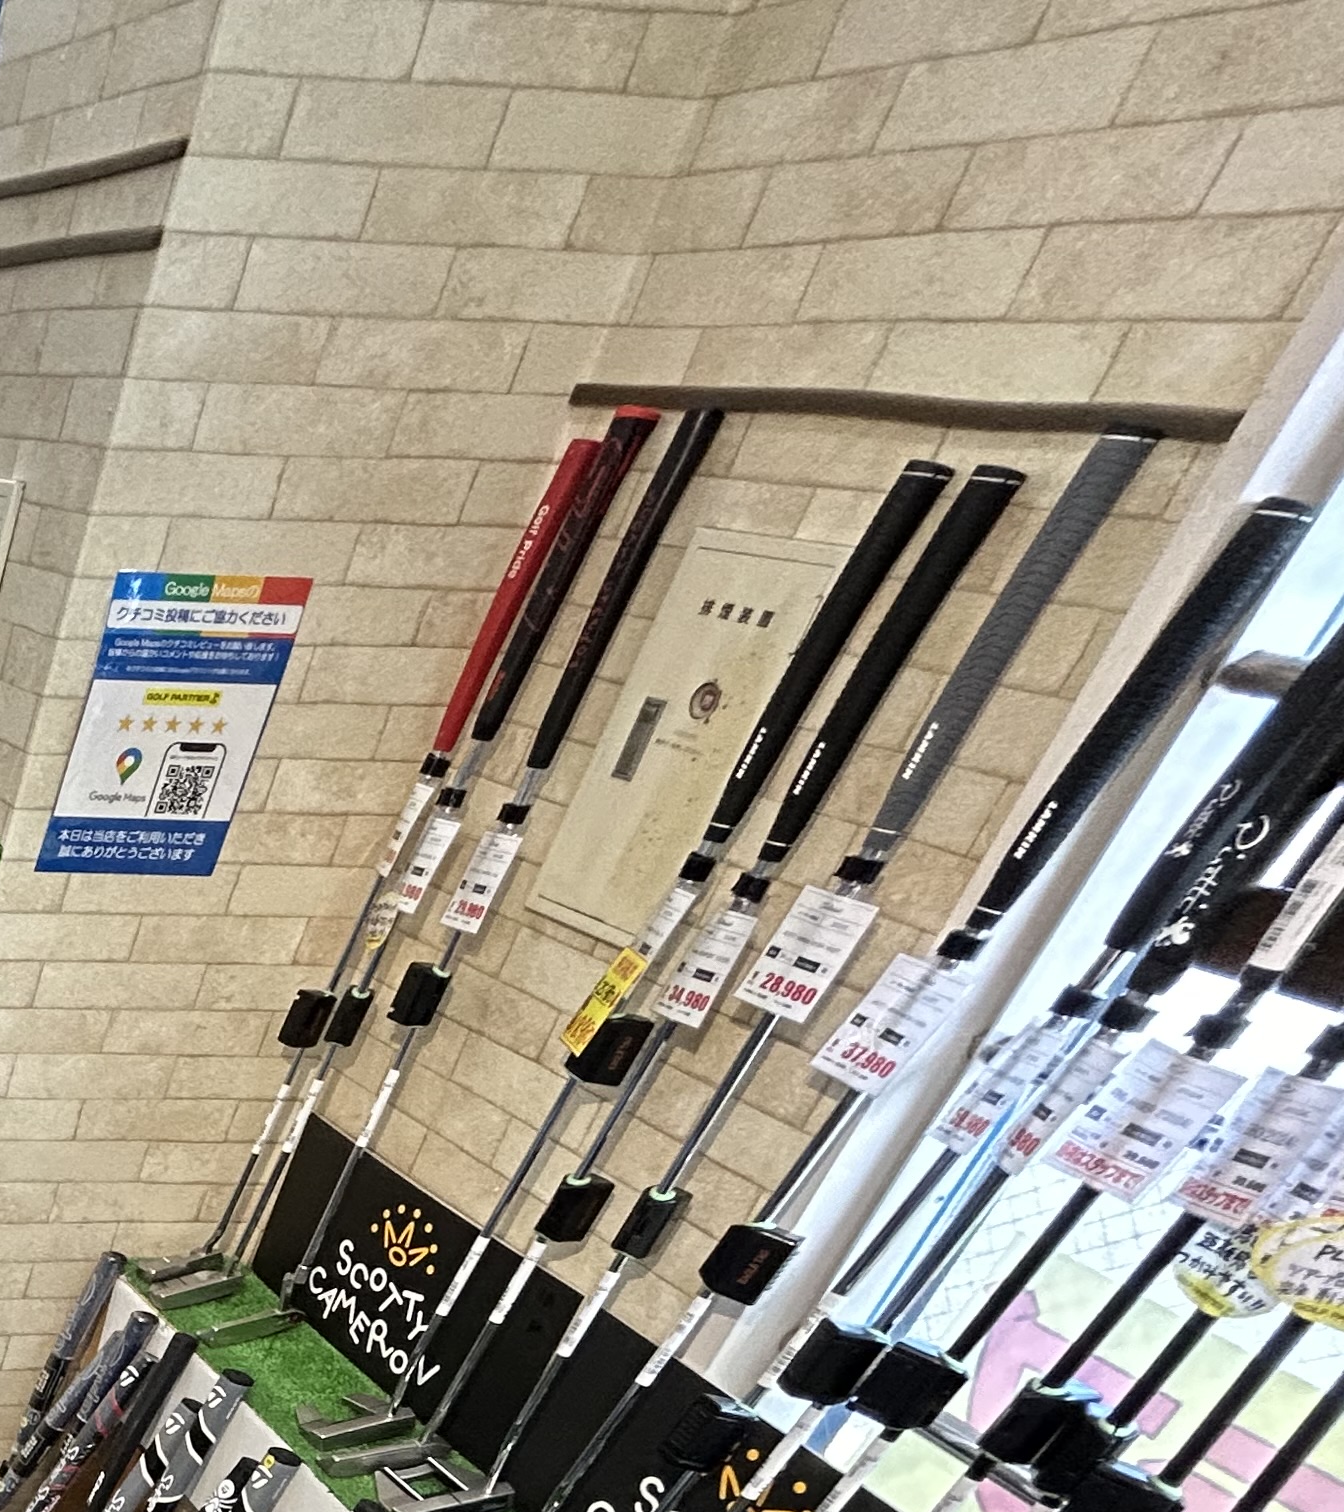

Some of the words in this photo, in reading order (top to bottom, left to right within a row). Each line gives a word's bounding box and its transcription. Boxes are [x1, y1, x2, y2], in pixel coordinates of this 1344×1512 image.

[520, 503, 550, 544] Golf
[507, 541, 534, 580] Pride
[164, 581, 209, 599] Google
[759, 971, 820, 1007] 28,980
[335, 1239, 432, 1342] SCOTTY
[309, 1266, 440, 1386] CAMERON
